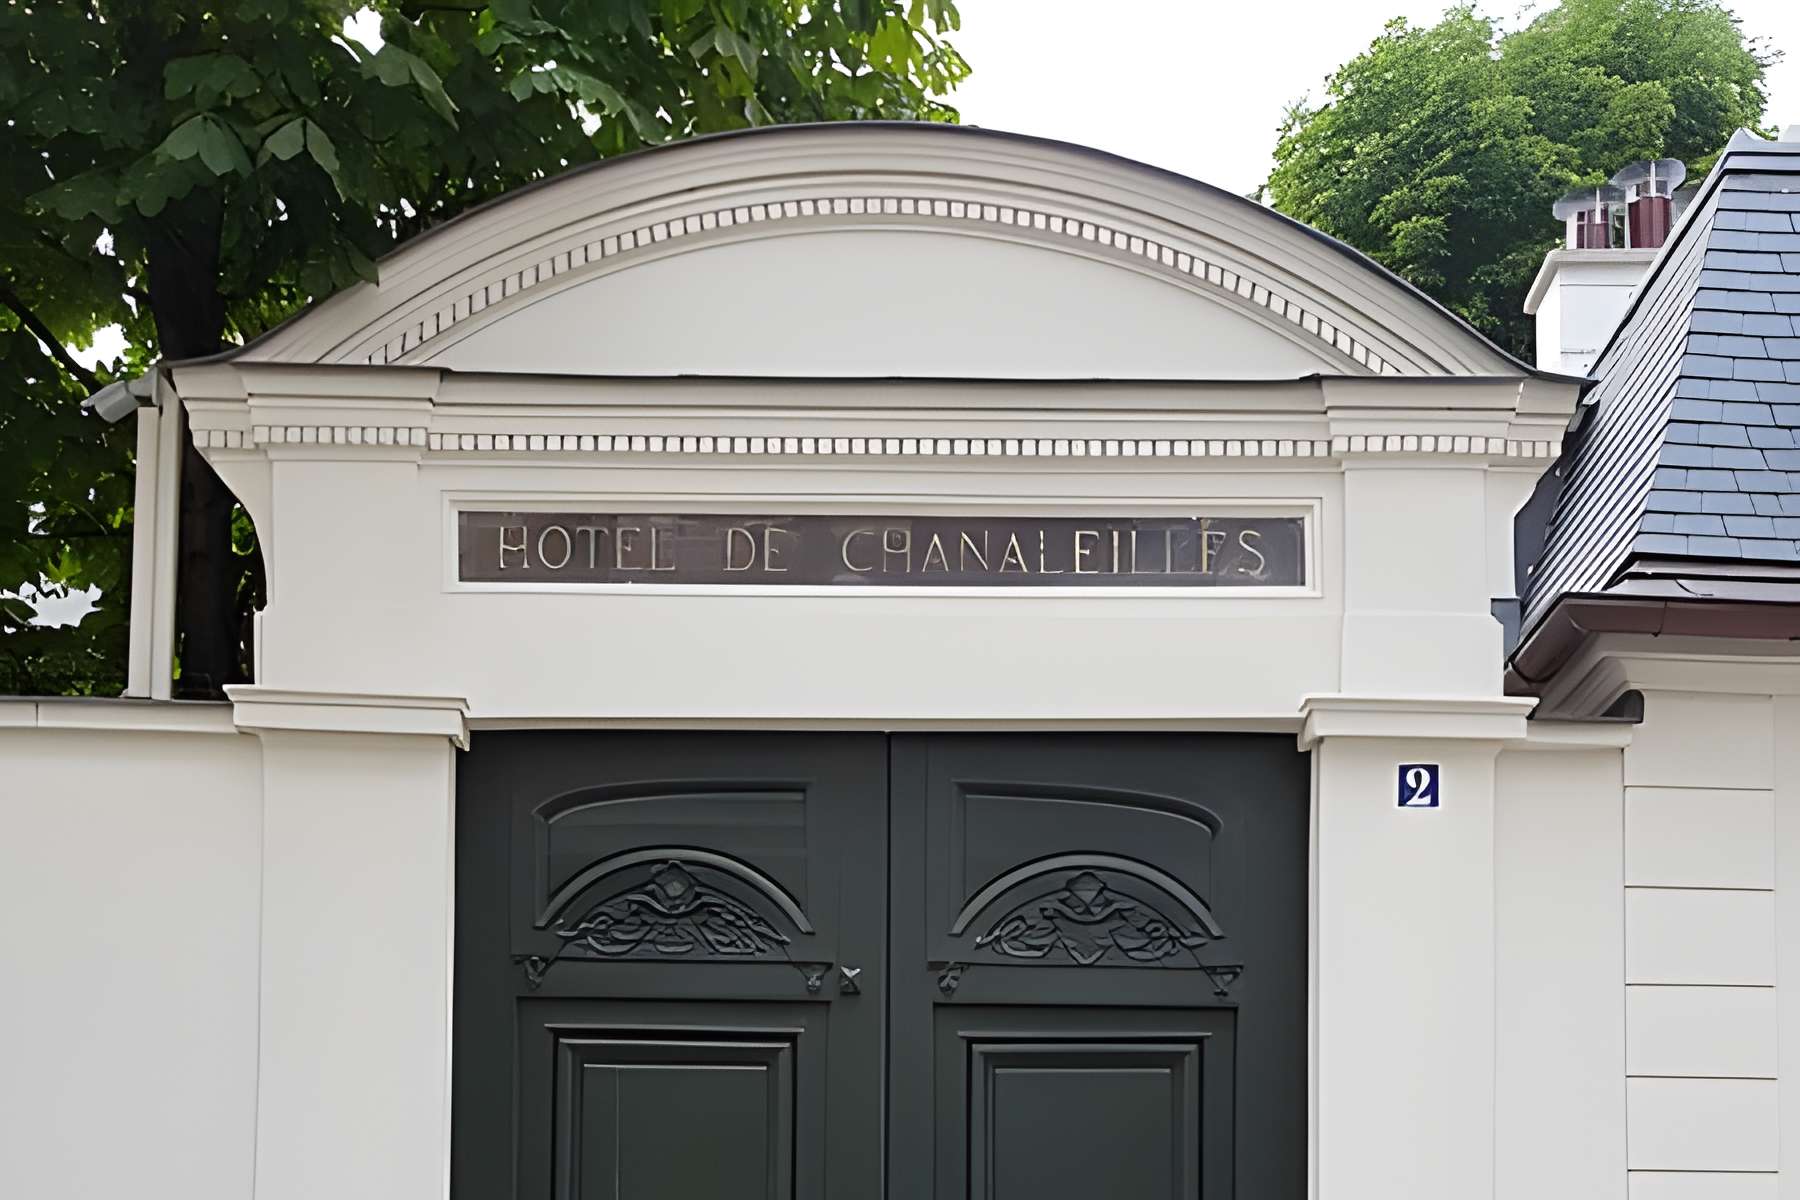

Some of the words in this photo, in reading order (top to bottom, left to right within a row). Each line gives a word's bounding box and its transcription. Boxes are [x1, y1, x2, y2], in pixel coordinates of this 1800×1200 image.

[499, 525, 676, 570] HOTEL
[723, 527, 789, 572] DE
[1406, 768, 1431, 805] 2
